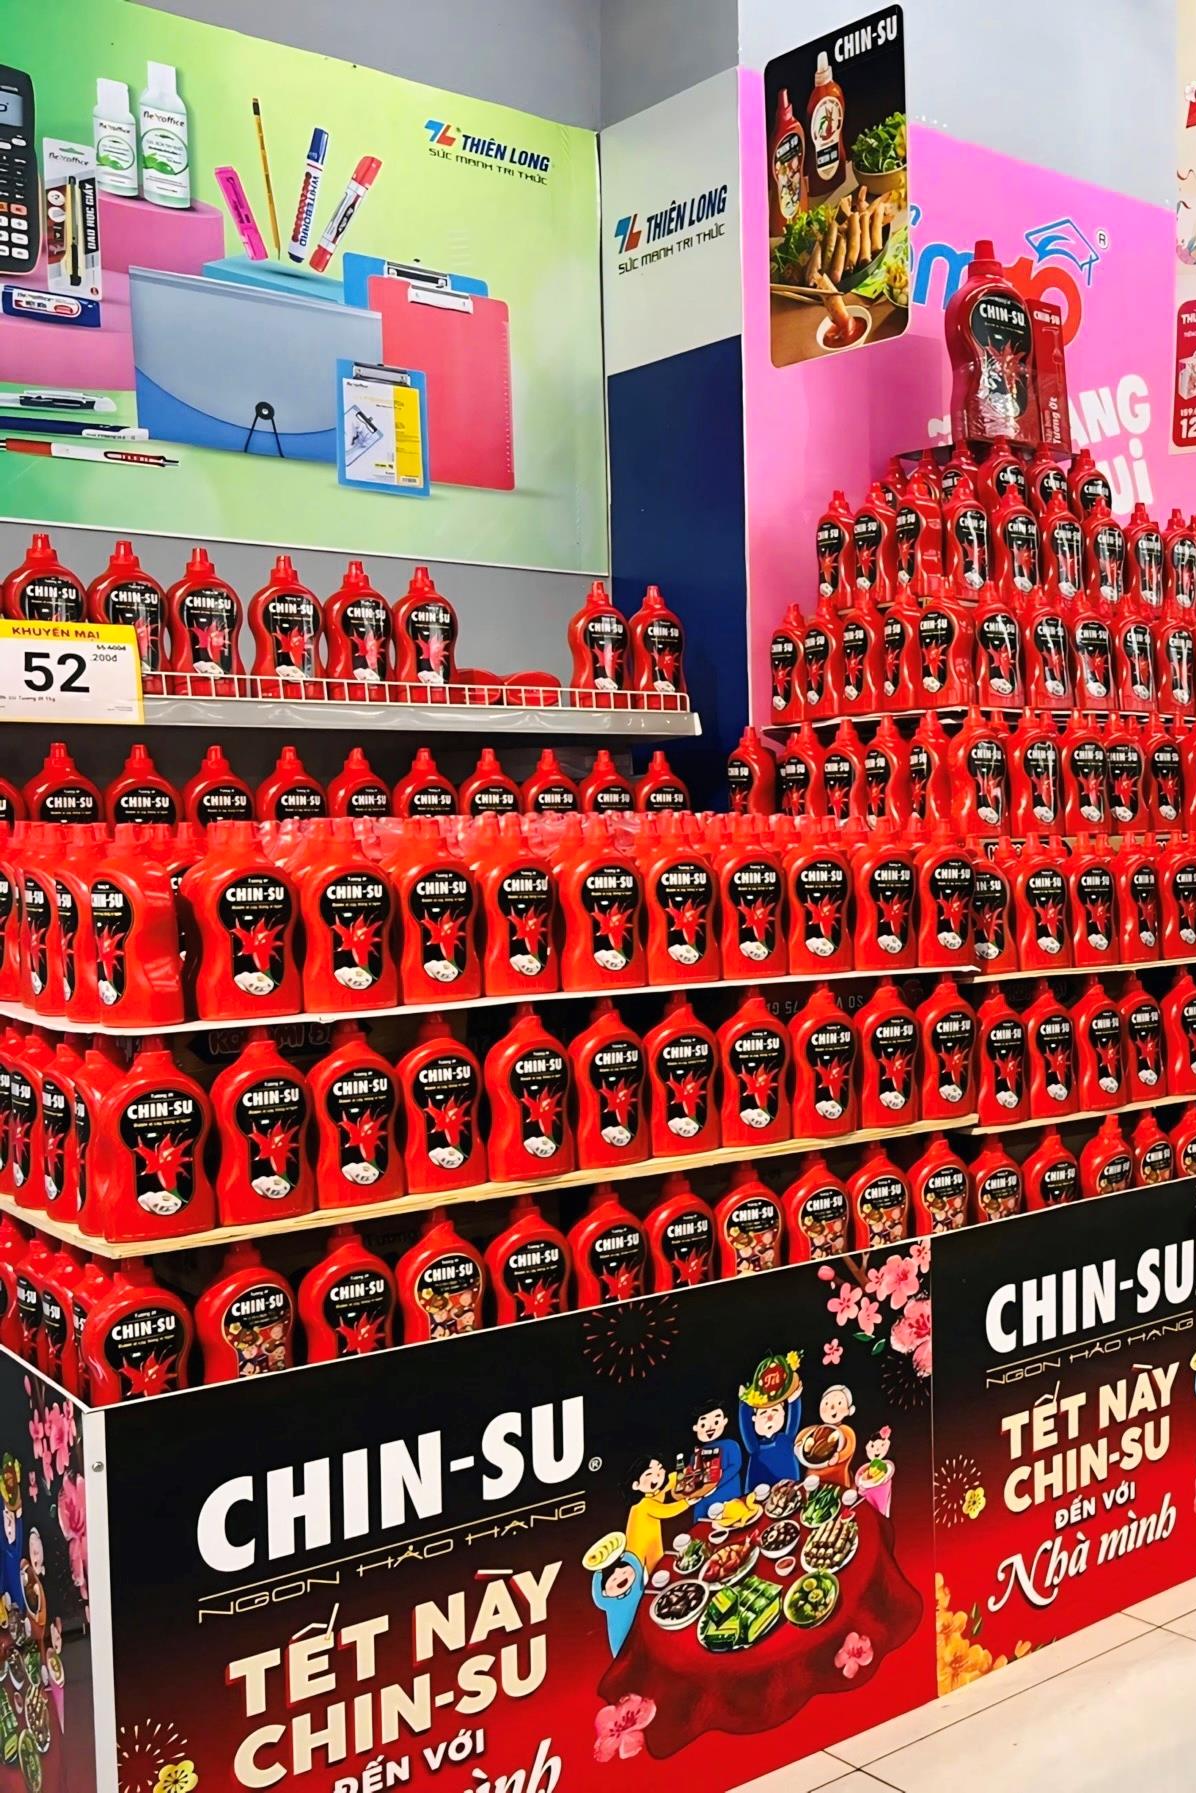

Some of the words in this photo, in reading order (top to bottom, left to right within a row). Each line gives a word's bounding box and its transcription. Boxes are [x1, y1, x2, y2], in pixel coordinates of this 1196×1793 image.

[834, 15, 897, 63] CHIN-SU
[461, 134, 507, 160] THIÊN
[509, 147, 551, 172] LONG
[646, 200, 687, 244] THIÊN
[688, 184, 728, 227] LONG
[618, 257, 638, 275] SỨC
[676, 237, 693, 252] TRI
[696, 223, 725, 244] THỨC
[979, 303, 1026, 327] CHIN-SU
[1033, 311, 1061, 325] CHIN-SU
[26, 585, 76, 600] CHIN-SU
[111, 591, 158, 604] CHIN-SU
[185, 596, 231, 609] CHIN-SU
[12, 626, 71, 638] KHUYẾN
[24, 651, 90, 693] 52
[45, 796, 93, 809] CHIN-SU
[120, 796, 170, 808] CHIN-SU
[586, 875, 634, 890] CHIN-SU
[874, 869, 911, 881] CHIN-SU
[1028, 876, 1062, 888] CHIN-SU
[225, 886, 284, 902] CHIN-SU
[326, 884, 383, 900] CHIN-SU
[734, 1037, 780, 1052] CHIN-SU
[990, 1028, 1022, 1041] CHIN-SU
[418, 1065, 471, 1084] CHIN-SU
[242, 1087, 300, 1107] CHIN-SU
[126, 1099, 193, 1120] CHIN-SU
[731, 1205, 774, 1223] CHIN-SU
[508, 1248, 559, 1269] CHIN-SU
[231, 1293, 284, 1317] CHIN-SU
[985, 1239, 1195, 1354] CHIN-SU
[111, 1315, 176, 1341] CHIN-SU
[986, 1358, 1061, 1389] NGON
[1127, 1317, 1194, 1345] HẠNG
[1001, 1380, 1087, 1461] TẾT
[1098, 1362, 1180, 1430] NÀY
[1003, 1416, 1170, 1513] CHIN-SU
[196, 1395, 585, 1573] CHIN-SU
[1054, 1490, 1097, 1530] ĐẾN
[1102, 1480, 1136, 1511] VỚI
[198, 1571, 341, 1624] NGON
[465, 1501, 586, 1546] HẠNG
[987, 1530, 1090, 1613] Nhà
[1097, 1492, 1177, 1566] mình
[226, 1602, 390, 1718] TẾT
[413, 1560, 563, 1667] NÀY
[233, 1634, 547, 1789] CHIN-SU
[333, 1754, 410, 1793] ĐẾN
[423, 1728, 485, 1772] VỚI
